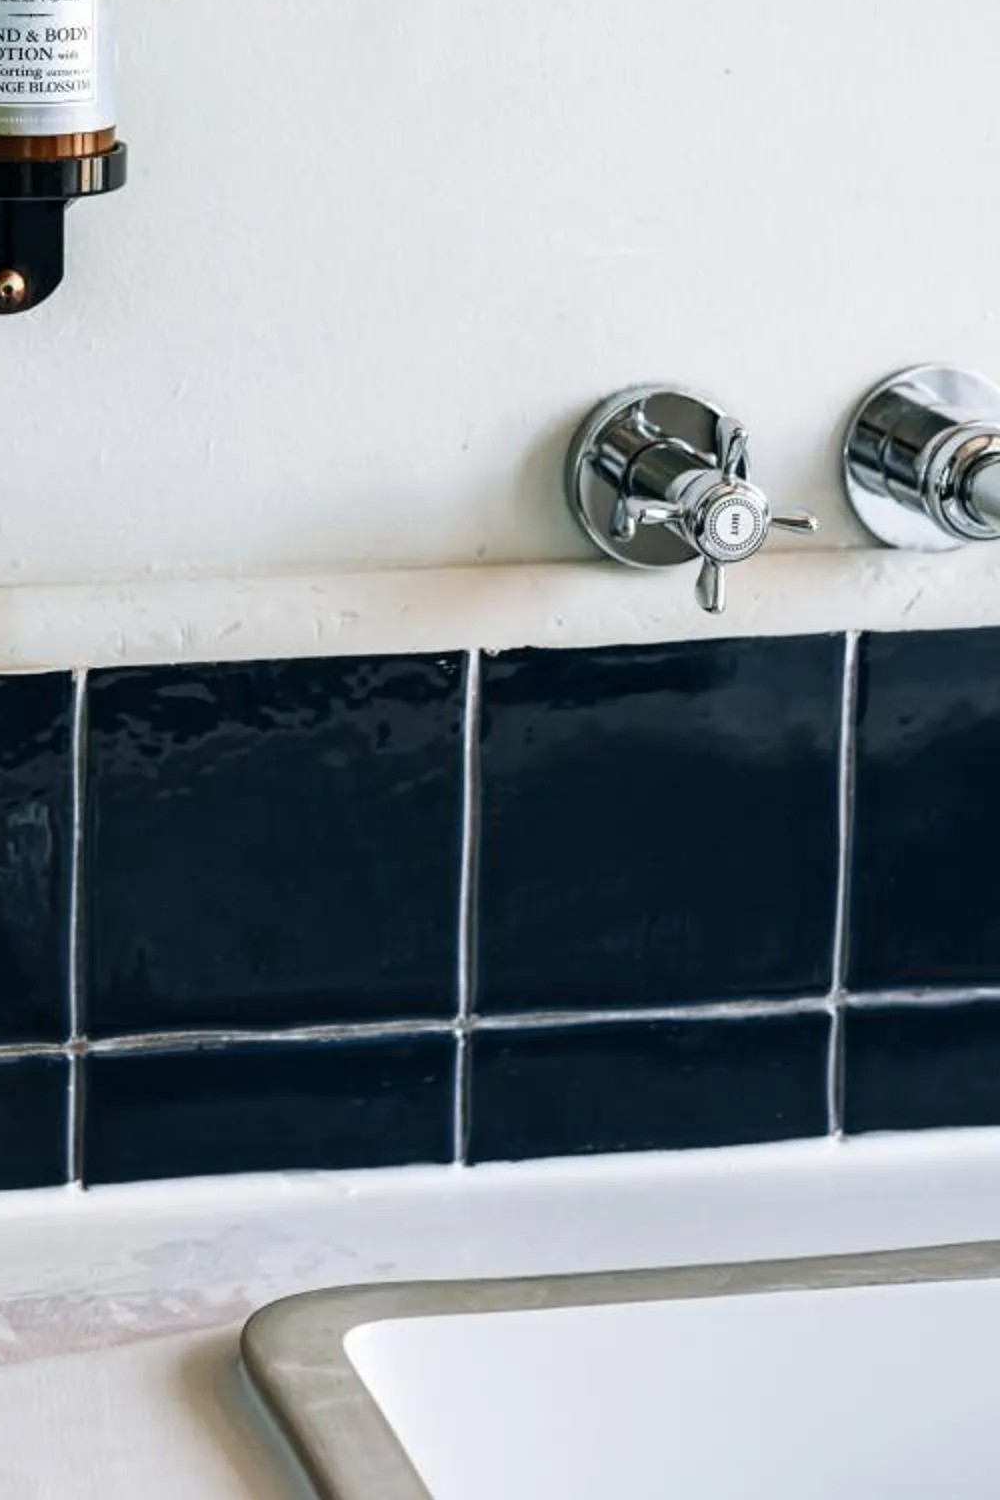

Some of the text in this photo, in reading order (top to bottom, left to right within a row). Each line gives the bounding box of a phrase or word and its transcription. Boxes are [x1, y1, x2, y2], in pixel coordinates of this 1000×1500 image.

[25, 29, 39, 43] &
[45, 26, 91, 42] BODY
[29, 79, 91, 93] BLOSSOM
